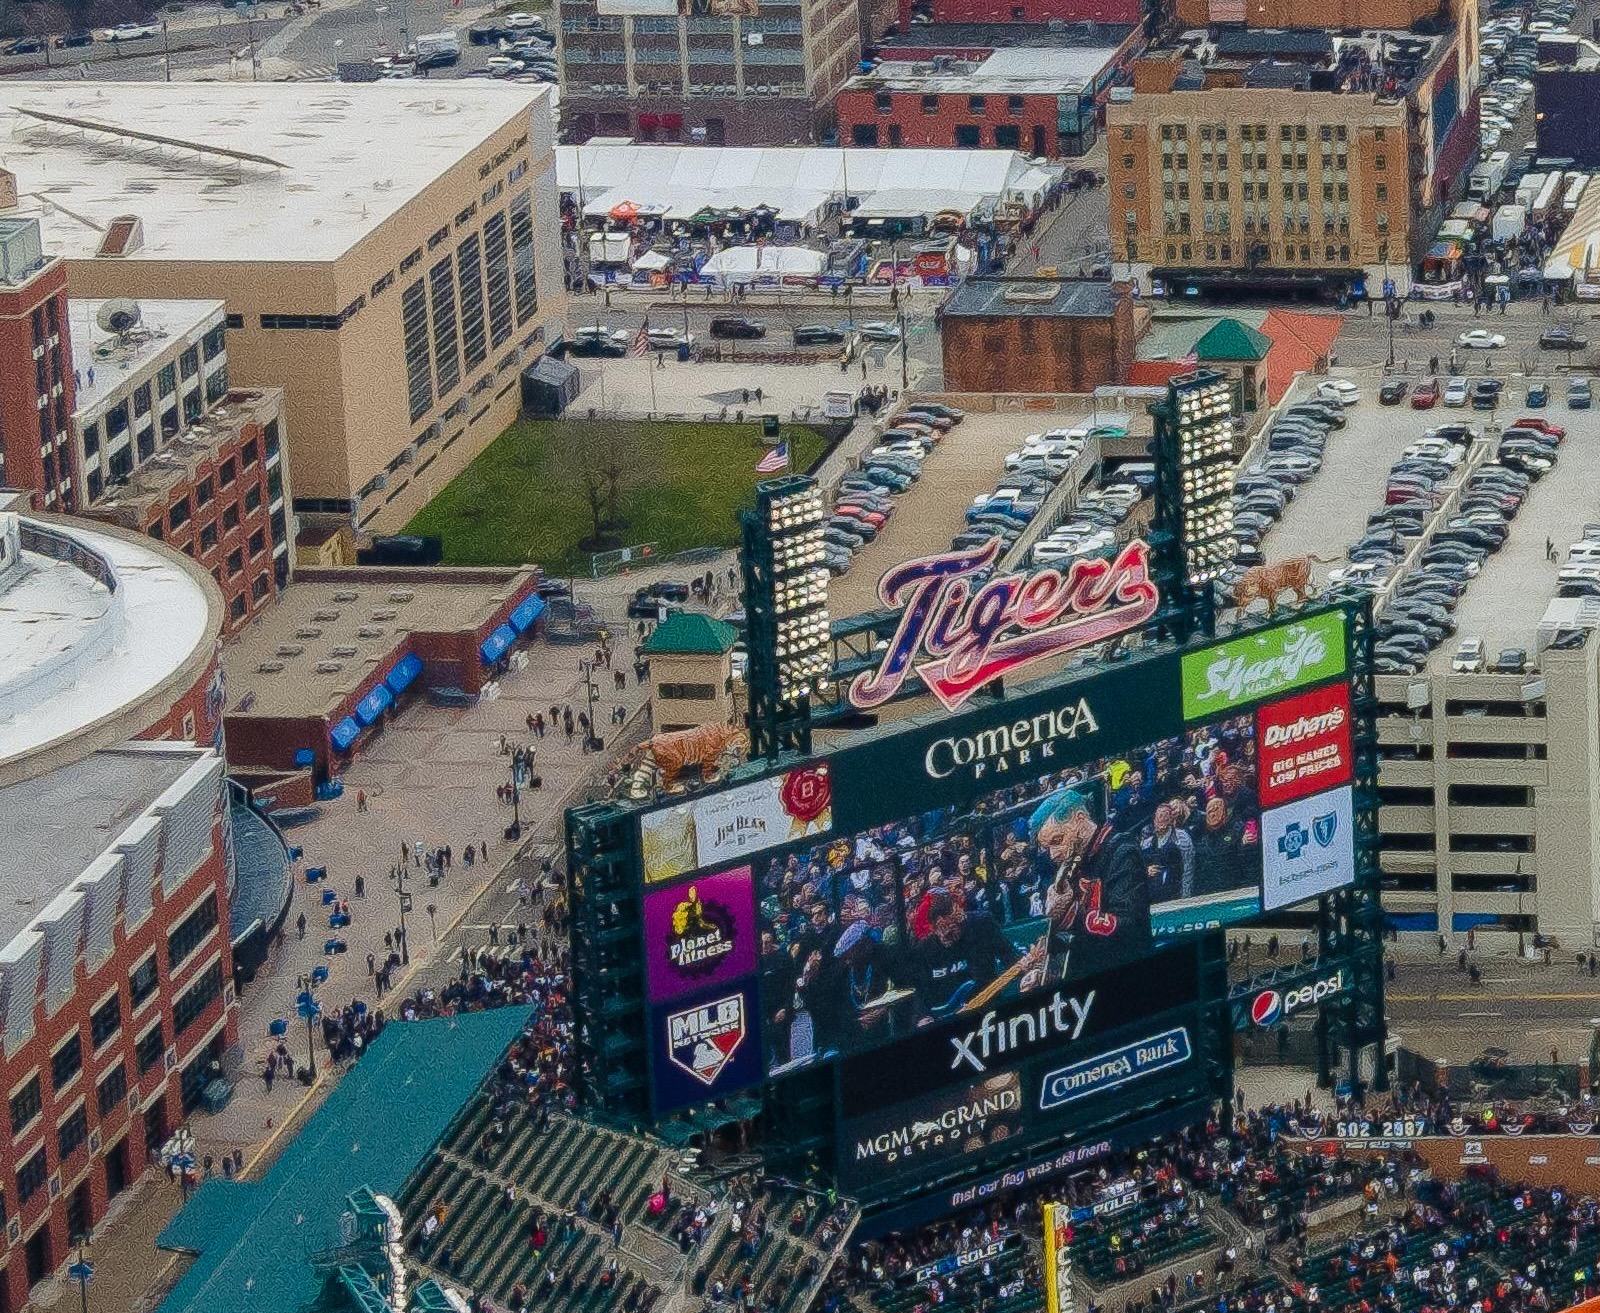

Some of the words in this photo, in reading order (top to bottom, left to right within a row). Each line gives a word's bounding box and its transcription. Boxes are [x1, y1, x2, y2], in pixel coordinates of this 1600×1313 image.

[850, 538, 1160, 712] Tigers
[975, 742, 1056, 780] PARK
[669, 928, 722, 957] planet
[678, 938, 733, 967] fitness
[1283, 969, 1345, 1015] pepsi
[671, 999, 741, 1041] MLB
[950, 988, 1096, 1072] xfinity
[1136, 1038, 1179, 1066] Bank
[856, 1125, 909, 1161] MGM
[941, 1090, 1017, 1130] GRAND
